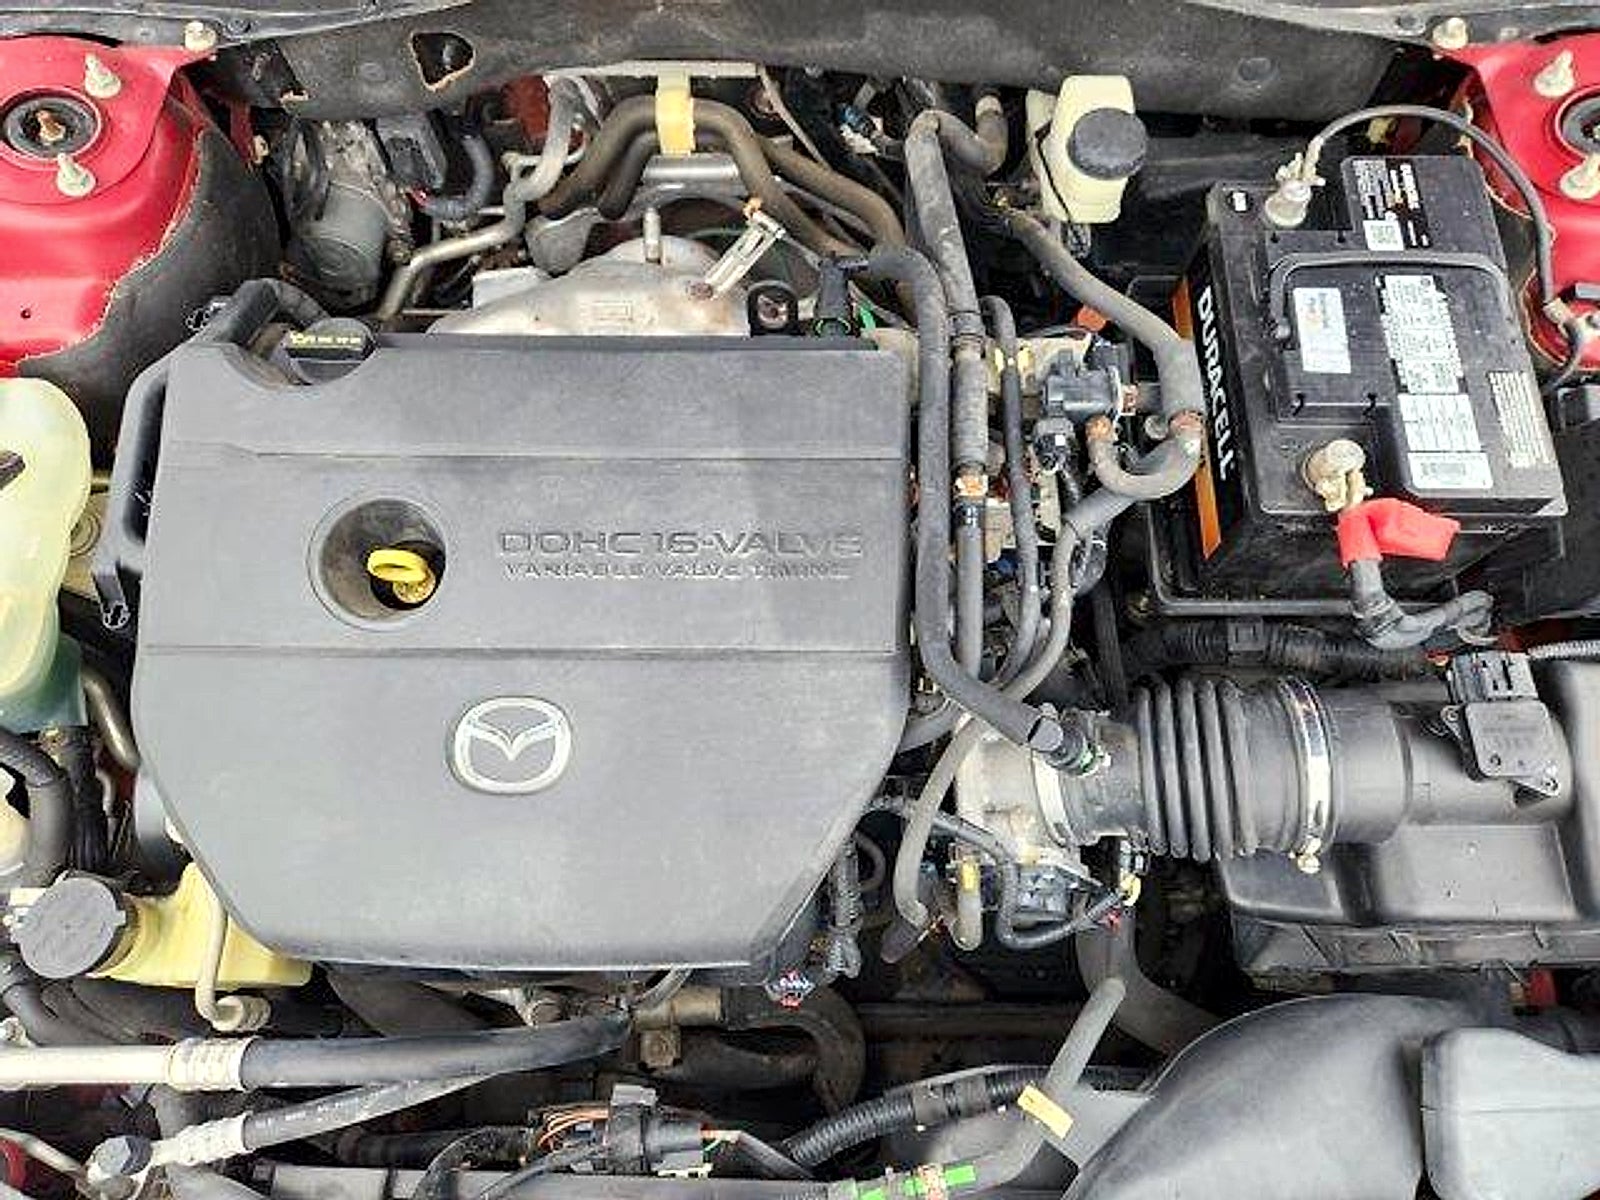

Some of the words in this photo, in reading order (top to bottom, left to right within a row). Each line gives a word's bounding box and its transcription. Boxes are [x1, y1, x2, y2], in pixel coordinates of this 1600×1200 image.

[1198, 285, 1234, 481] DURACELL
[499, 531, 643, 556] DOHC
[651, 531, 863, 558] 16-VALVE
[503, 563, 645, 580] VARIABLE
[655, 563, 743, 580] VALVE
